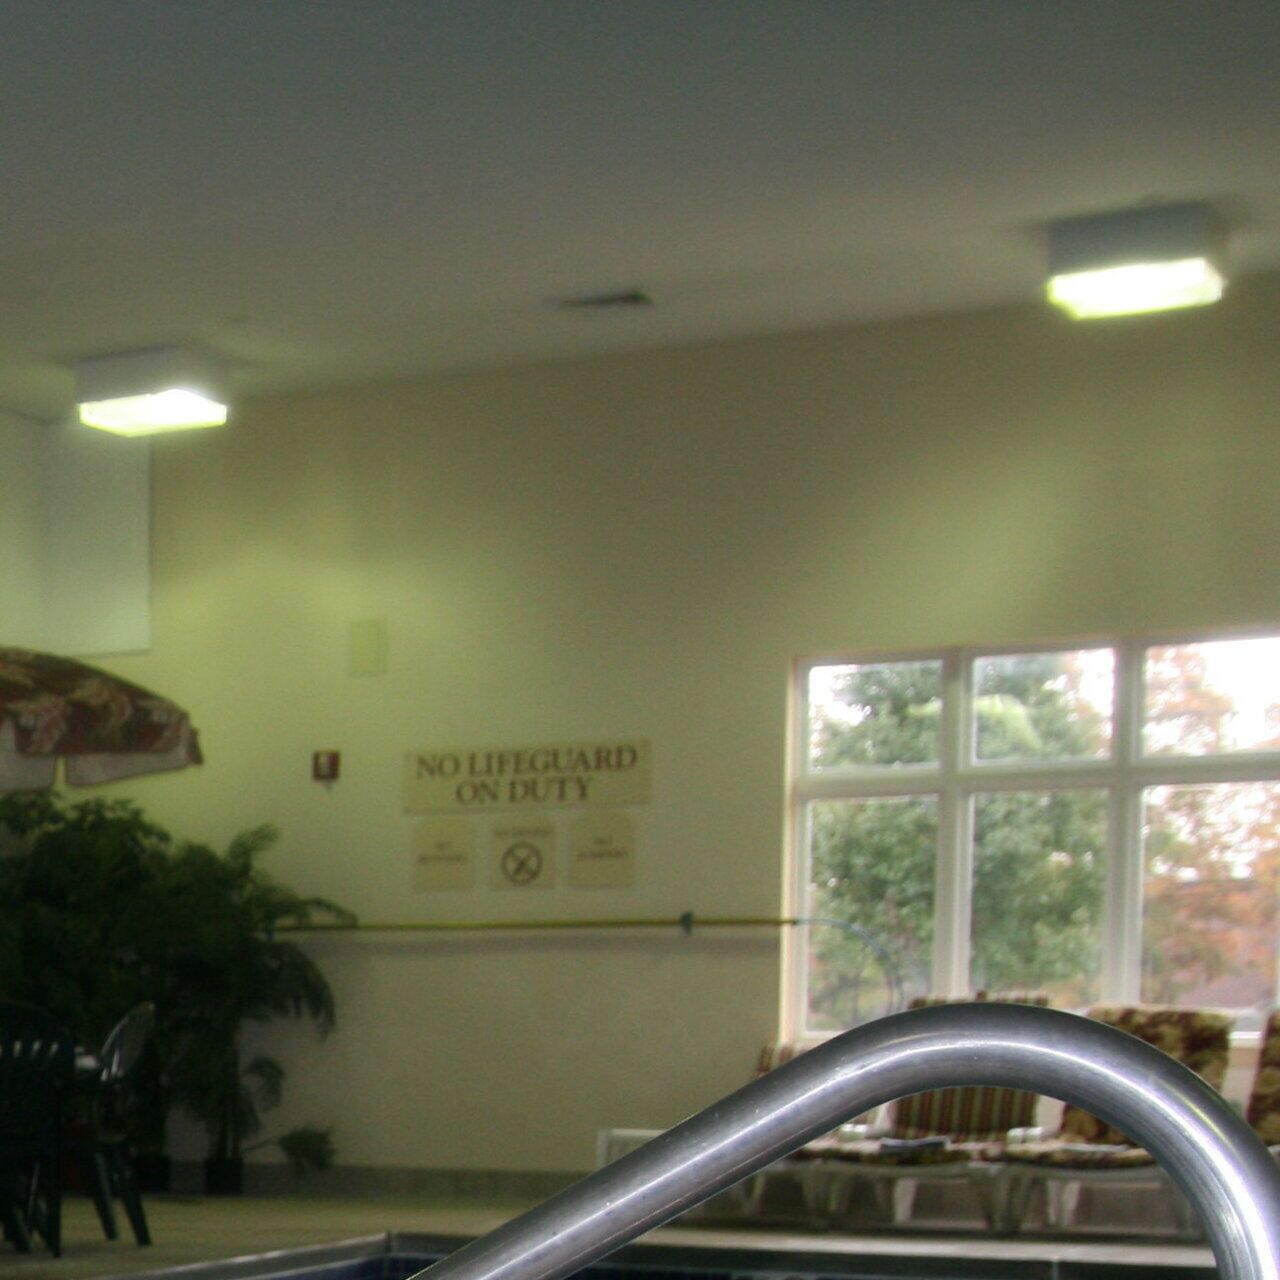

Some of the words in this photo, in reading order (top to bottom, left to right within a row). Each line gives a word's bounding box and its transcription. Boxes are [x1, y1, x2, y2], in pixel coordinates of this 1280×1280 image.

[417, 752, 461, 779] NO
[468, 745, 637, 777] LIFEGUARD
[455, 777, 500, 804] ON
[509, 776, 592, 803] DUTY
